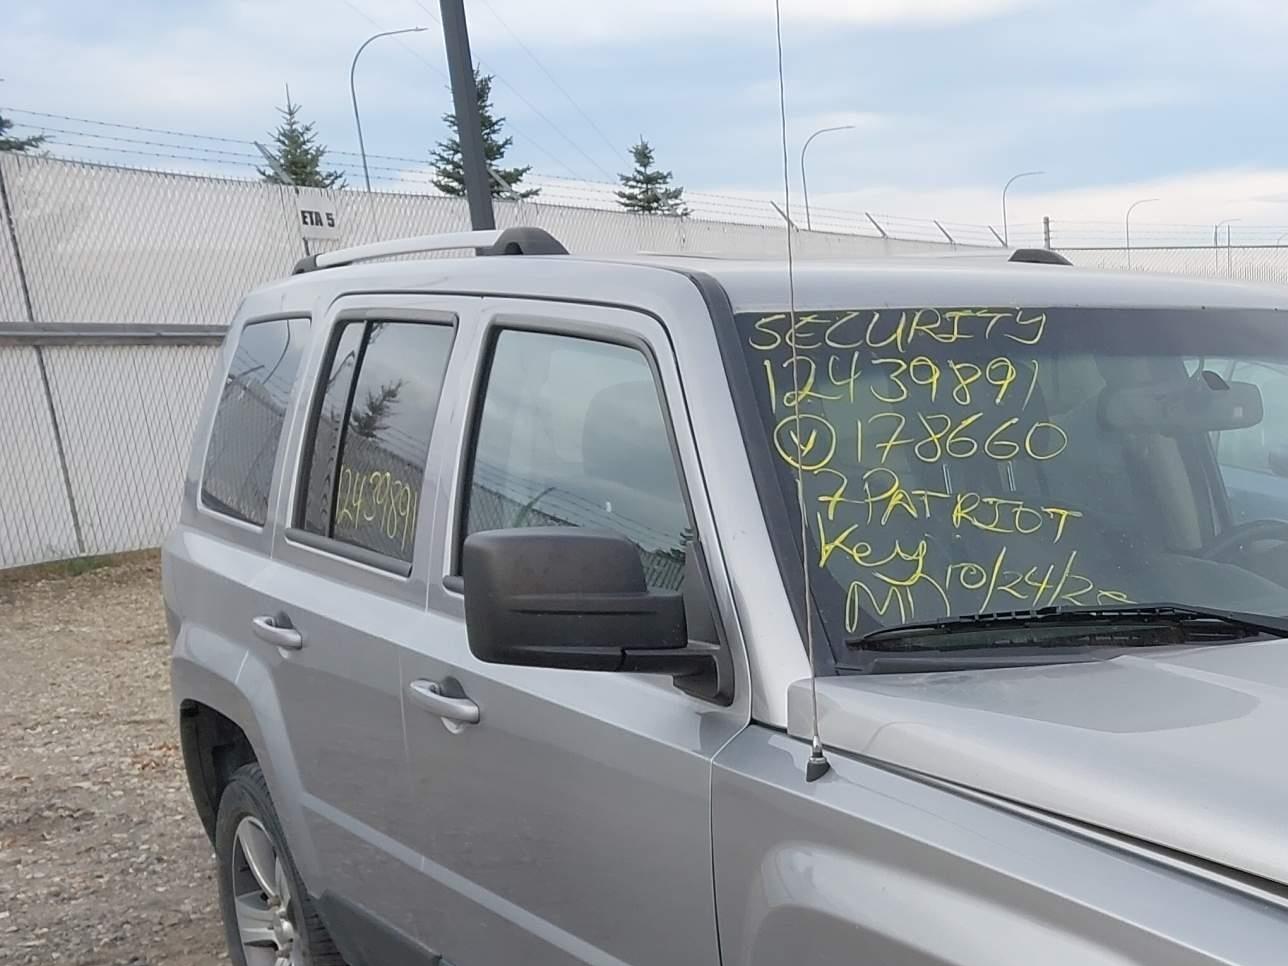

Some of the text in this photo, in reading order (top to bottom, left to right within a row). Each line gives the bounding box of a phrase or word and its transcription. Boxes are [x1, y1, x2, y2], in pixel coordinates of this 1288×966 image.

[326, 212, 335, 227] 5
[749, 308, 1046, 352] SECURITY
[764, 351, 1039, 414] 12439891
[857, 412, 1068, 462] 178660
[336, 464, 418, 551] 12439891
[862, 468, 1084, 543] PATRIOT
